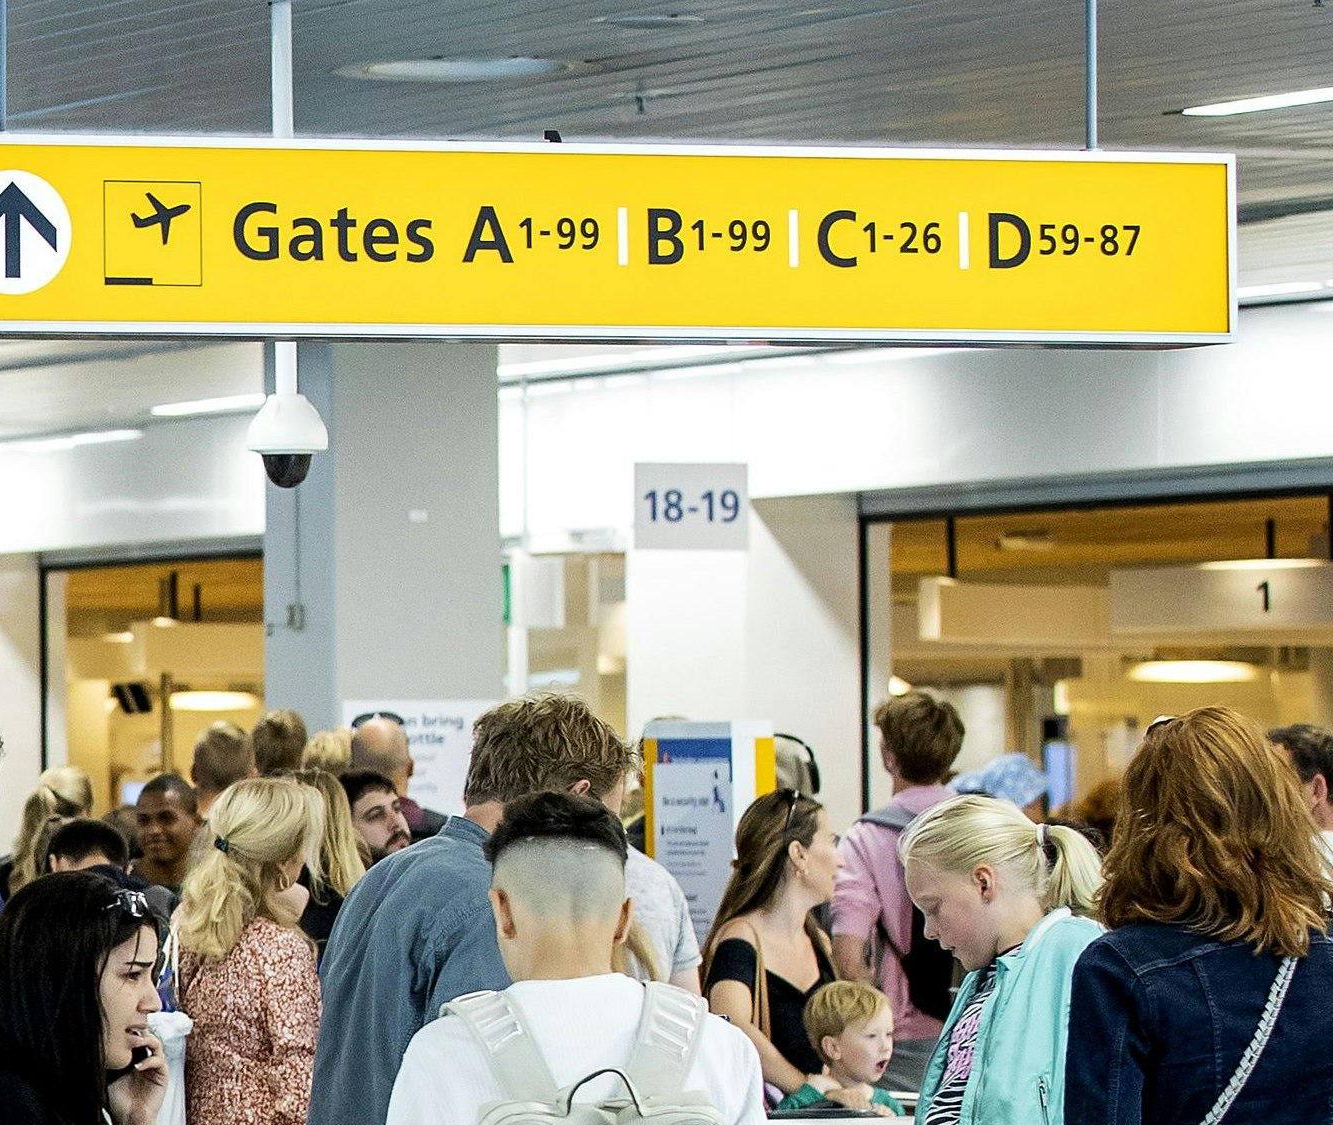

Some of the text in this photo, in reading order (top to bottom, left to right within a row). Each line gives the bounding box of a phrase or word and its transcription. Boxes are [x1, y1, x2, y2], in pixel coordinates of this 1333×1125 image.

[233, 202, 435, 264] Gates
[644, 489, 740, 523] 18-19
[1256, 580, 1270, 613] 1
